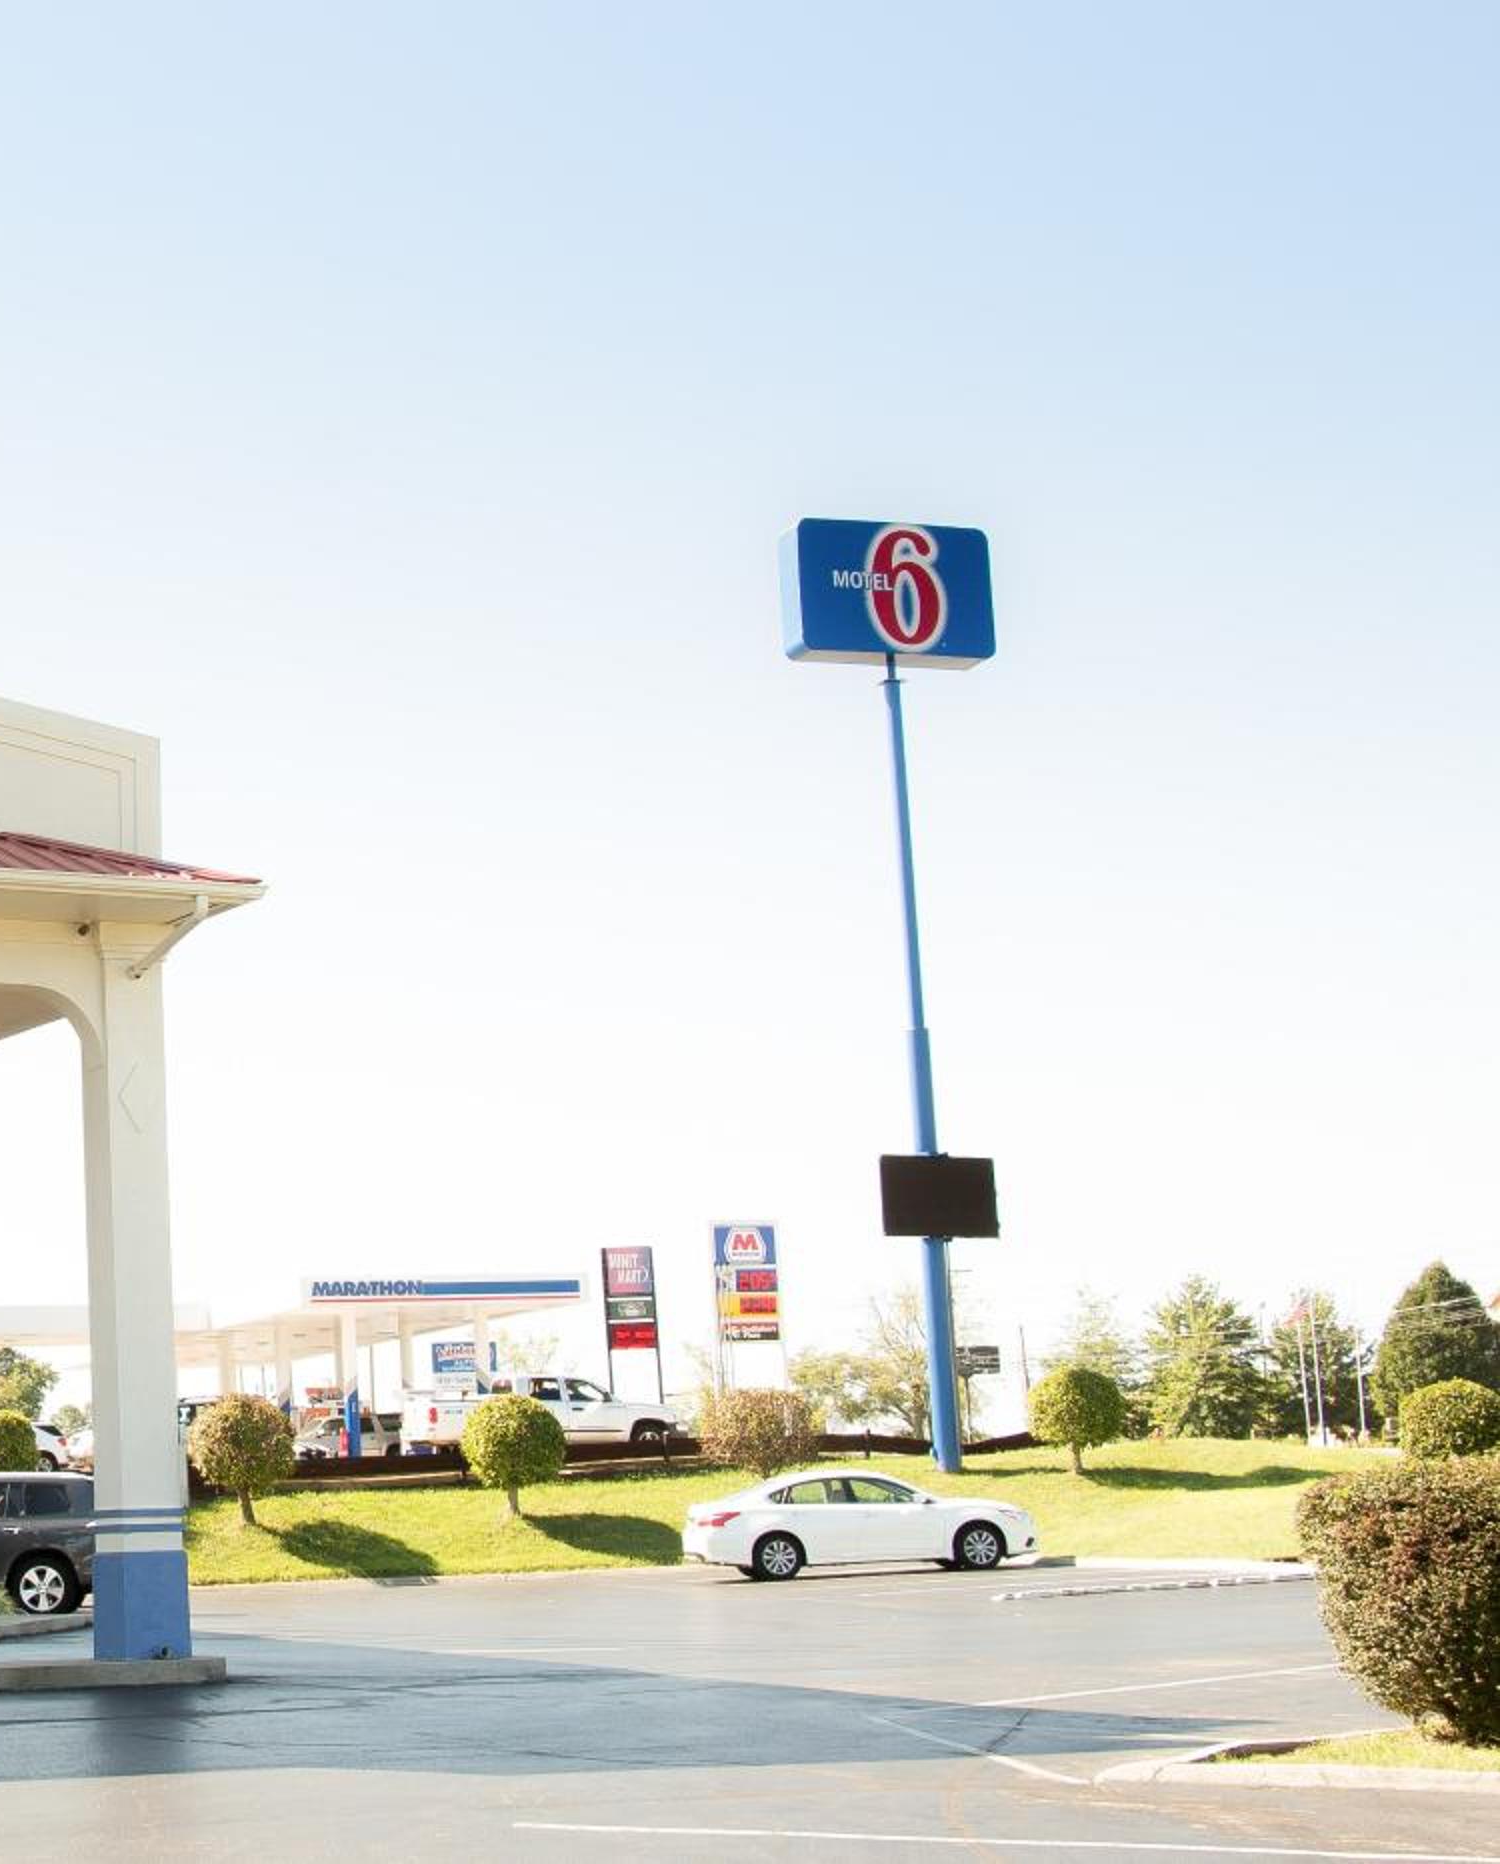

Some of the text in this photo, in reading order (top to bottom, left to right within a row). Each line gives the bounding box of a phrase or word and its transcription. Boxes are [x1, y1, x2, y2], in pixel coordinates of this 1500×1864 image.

[833, 527, 944, 648] MOTEL 6
[311, 1281, 422, 1297] MARATHON
